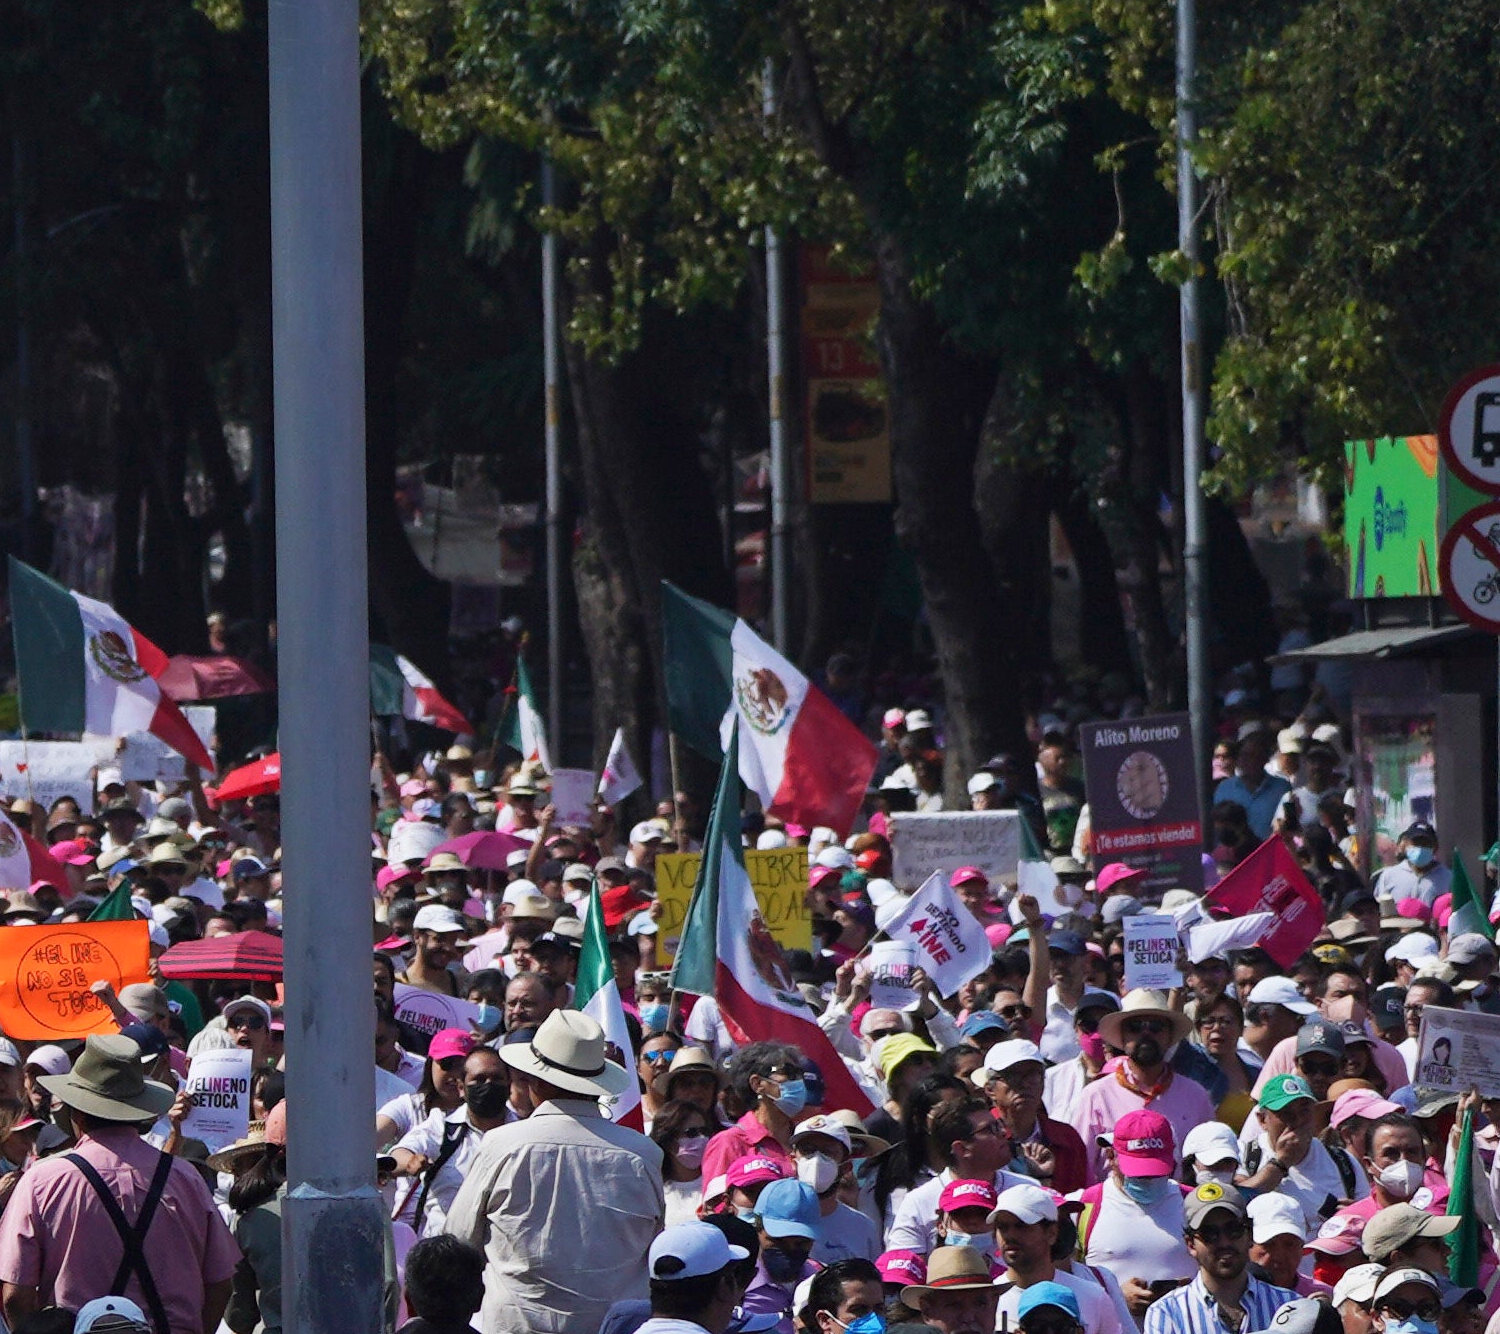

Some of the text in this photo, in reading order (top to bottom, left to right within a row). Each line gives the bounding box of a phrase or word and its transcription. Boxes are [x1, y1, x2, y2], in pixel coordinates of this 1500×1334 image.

[1094, 724, 1180, 748] Alito Moreno
[1095, 823, 1197, 853] ¡Te estamos viendo!
[924, 902, 966, 953] DEFIENDO
[70, 939, 102, 964] INE
[917, 931, 952, 967] INE
[1134, 952, 1173, 966] SETOCA
[26, 967, 90, 991] NO SE
[401, 1008, 448, 1030] #ELINENO
[192, 1076, 248, 1095] ELINENO
[192, 1092, 239, 1110] SETOCA
